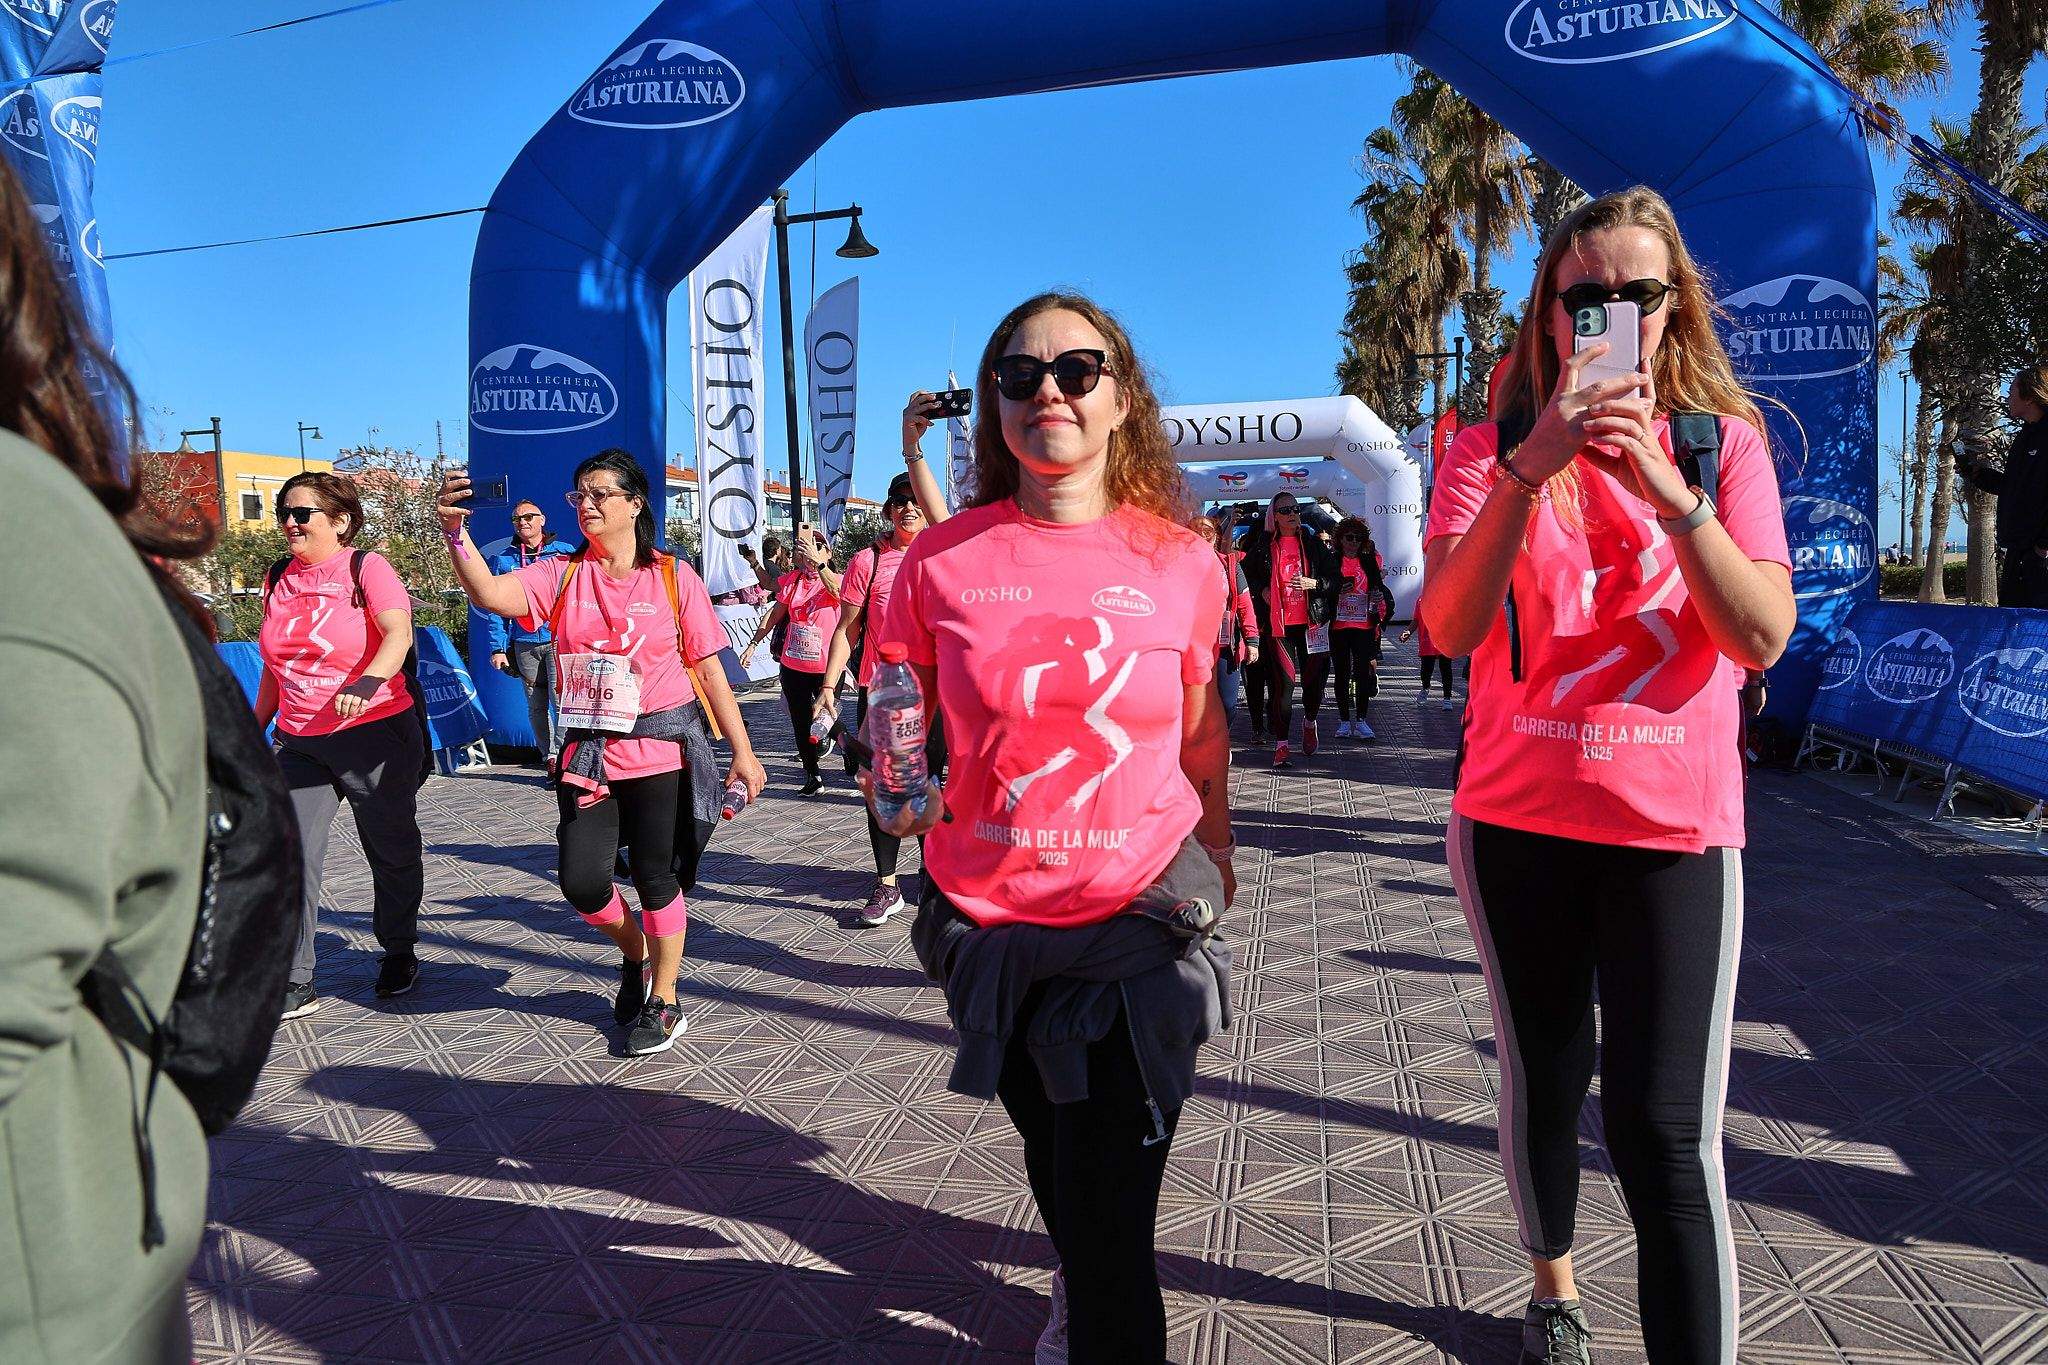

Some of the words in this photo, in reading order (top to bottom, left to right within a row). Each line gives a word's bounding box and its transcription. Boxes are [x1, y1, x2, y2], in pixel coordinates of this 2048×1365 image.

[1523, 0, 1726, 48] ASTURIANA
[604, 67, 656, 83] CENTRAL
[661, 66, 723, 76] LECHERA
[575, 80, 731, 112] ASTURIANA
[1733, 311, 1807, 325] ENTRAL
[1815, 309, 1868, 320] LECHERA
[1728, 324, 1870, 358] STURIANA
[482, 375, 530, 386] CENTRAL
[536, 375, 599, 388] LECHERA
[470, 381, 605, 415] ASTURIANA
[703, 278, 757, 540] OYSHO
[814, 331, 855, 536] OYSHO
[1347, 440, 1394, 453] OYSHO
[1374, 504, 1417, 515] OYSHO
[1793, 543, 1871, 572] RIANA
[1386, 565, 1418, 576] YSHO
[961, 586, 1033, 604] OYSHO
[588, 687, 614, 700] 016
[1512, 714, 1578, 741] CARRERA
[1582, 723, 1604, 743] DE
[1609, 725, 1631, 743] LA
[1633, 725, 1686, 745] MUJER
[1583, 746, 1613, 760] 2025
[974, 819, 1031, 849] CARRERA
[1036, 829, 1058, 849] DE
[1063, 829, 1083, 849] LA
[1038, 851, 1069, 866] 2025
